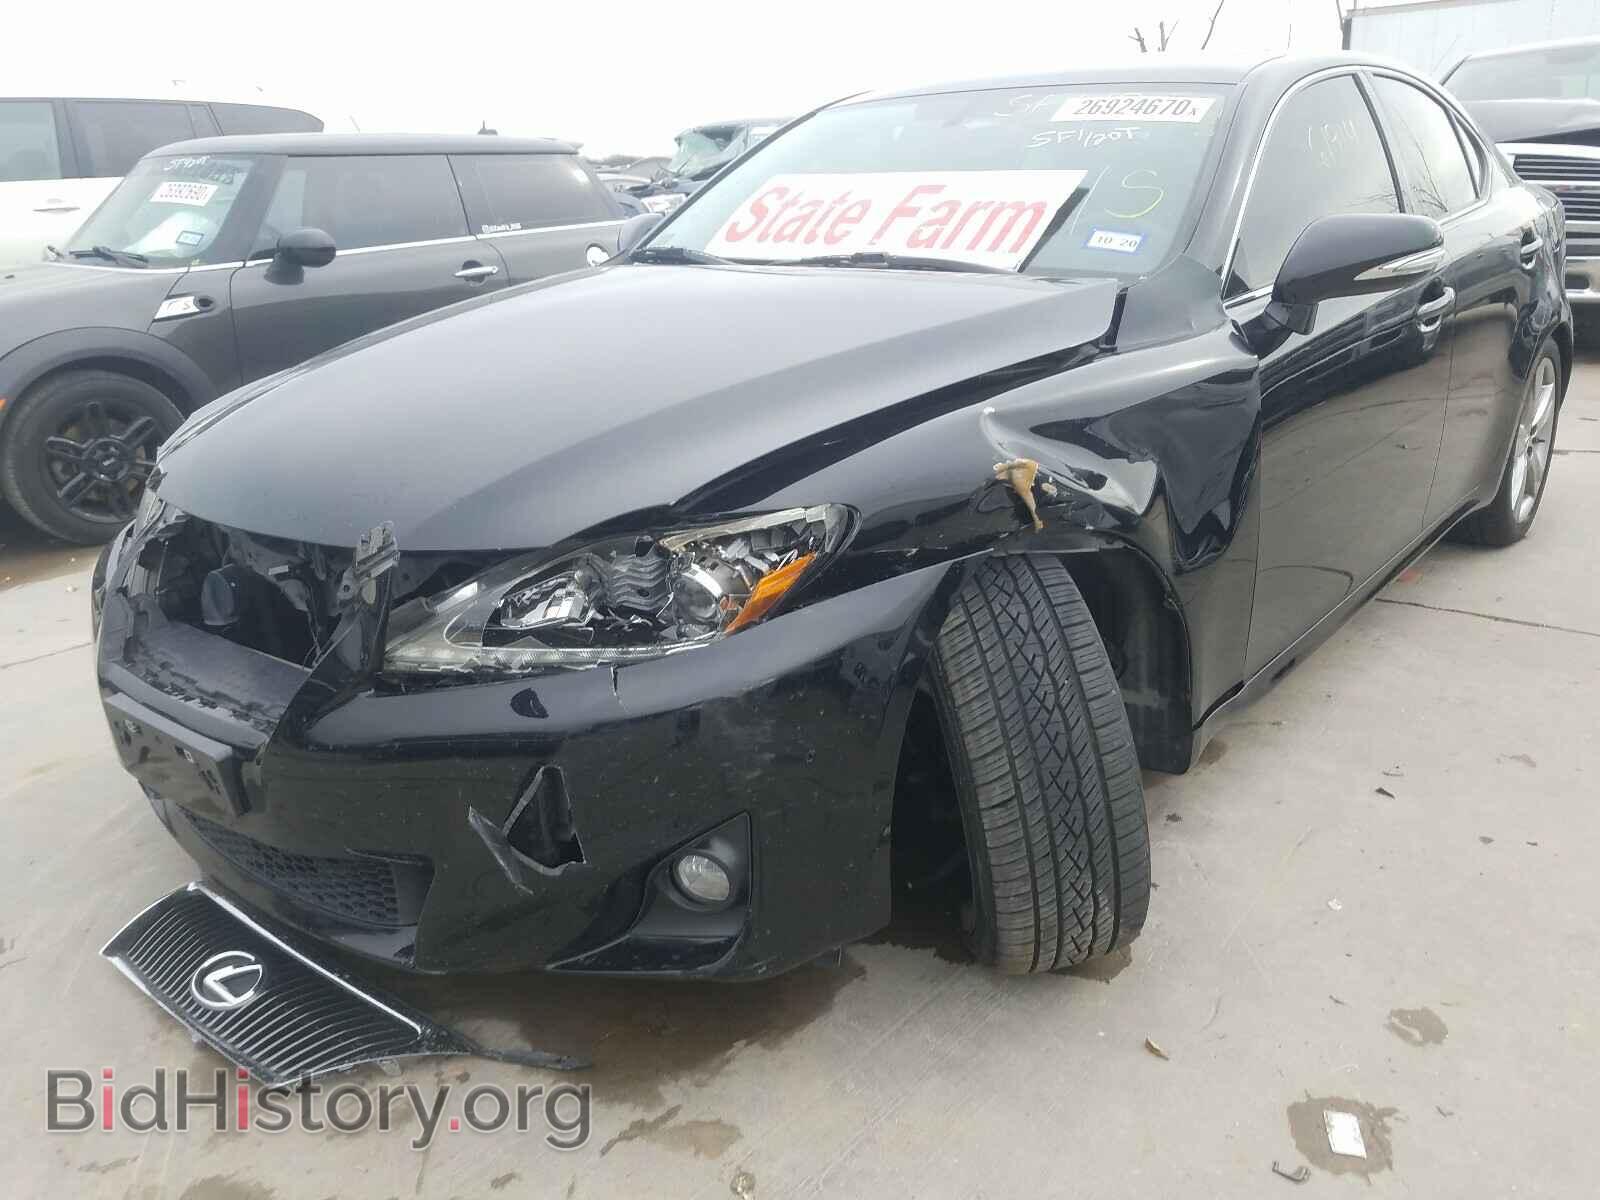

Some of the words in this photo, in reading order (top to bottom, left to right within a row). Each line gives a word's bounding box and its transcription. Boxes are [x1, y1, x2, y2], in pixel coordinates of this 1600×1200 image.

[1074, 98, 1191, 116] 26924670
[725, 186, 871, 246] State
[868, 184, 1047, 254] Farm
[1119, 239, 1138, 249] 20
